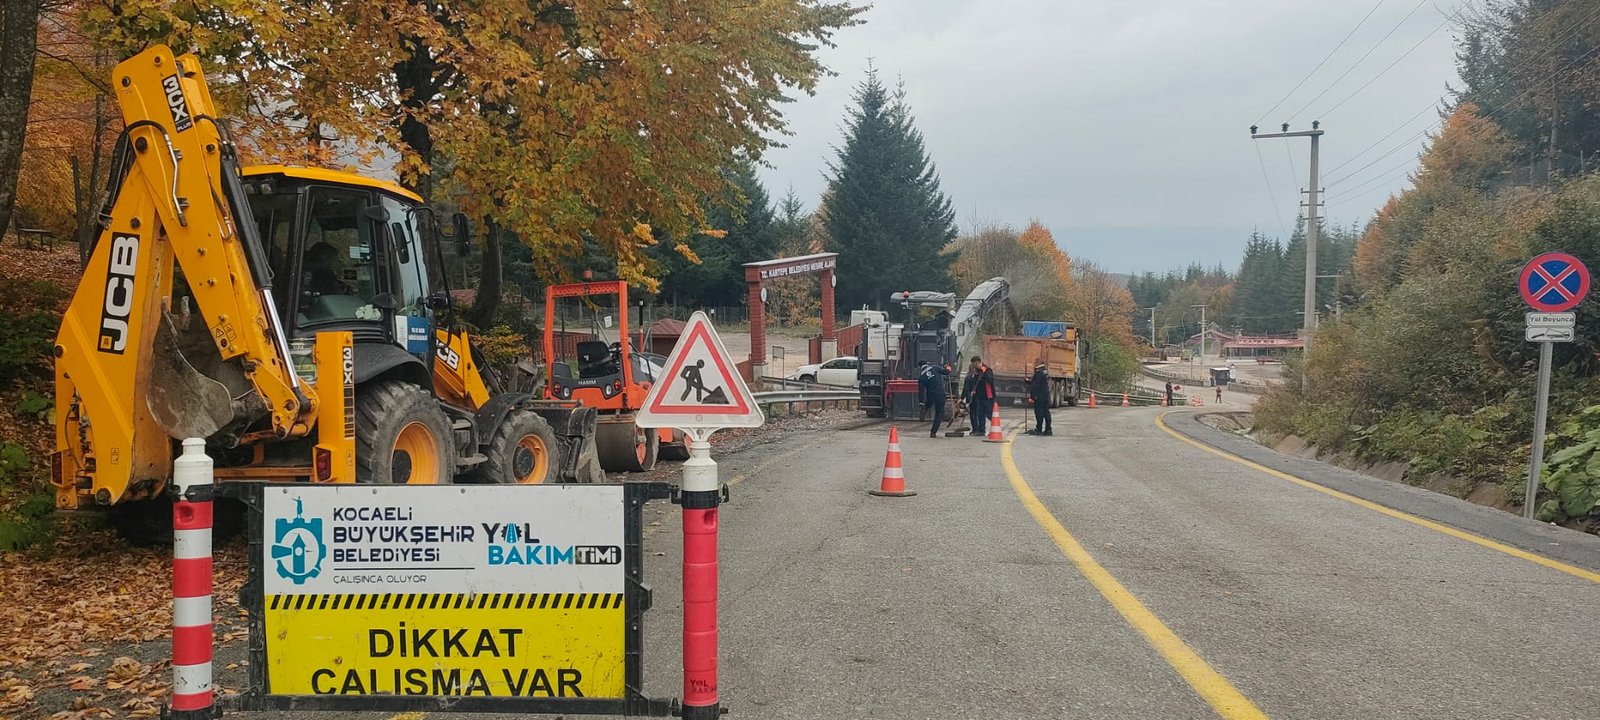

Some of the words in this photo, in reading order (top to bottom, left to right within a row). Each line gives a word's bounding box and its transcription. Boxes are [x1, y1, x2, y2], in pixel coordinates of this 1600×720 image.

[163, 76, 189, 122] 3CX
[102, 236, 139, 351] JCB
[343, 347, 353, 384] 3CX
[436, 339, 460, 369] CB
[481, 523, 540, 544] YOL
[488, 545, 574, 565] BAKIM
[386, 575, 427, 584] OLUYOR
[368, 621, 523, 658] DİKKAT
[502, 668, 585, 698] VAR
[690, 679, 709, 688] YOL
